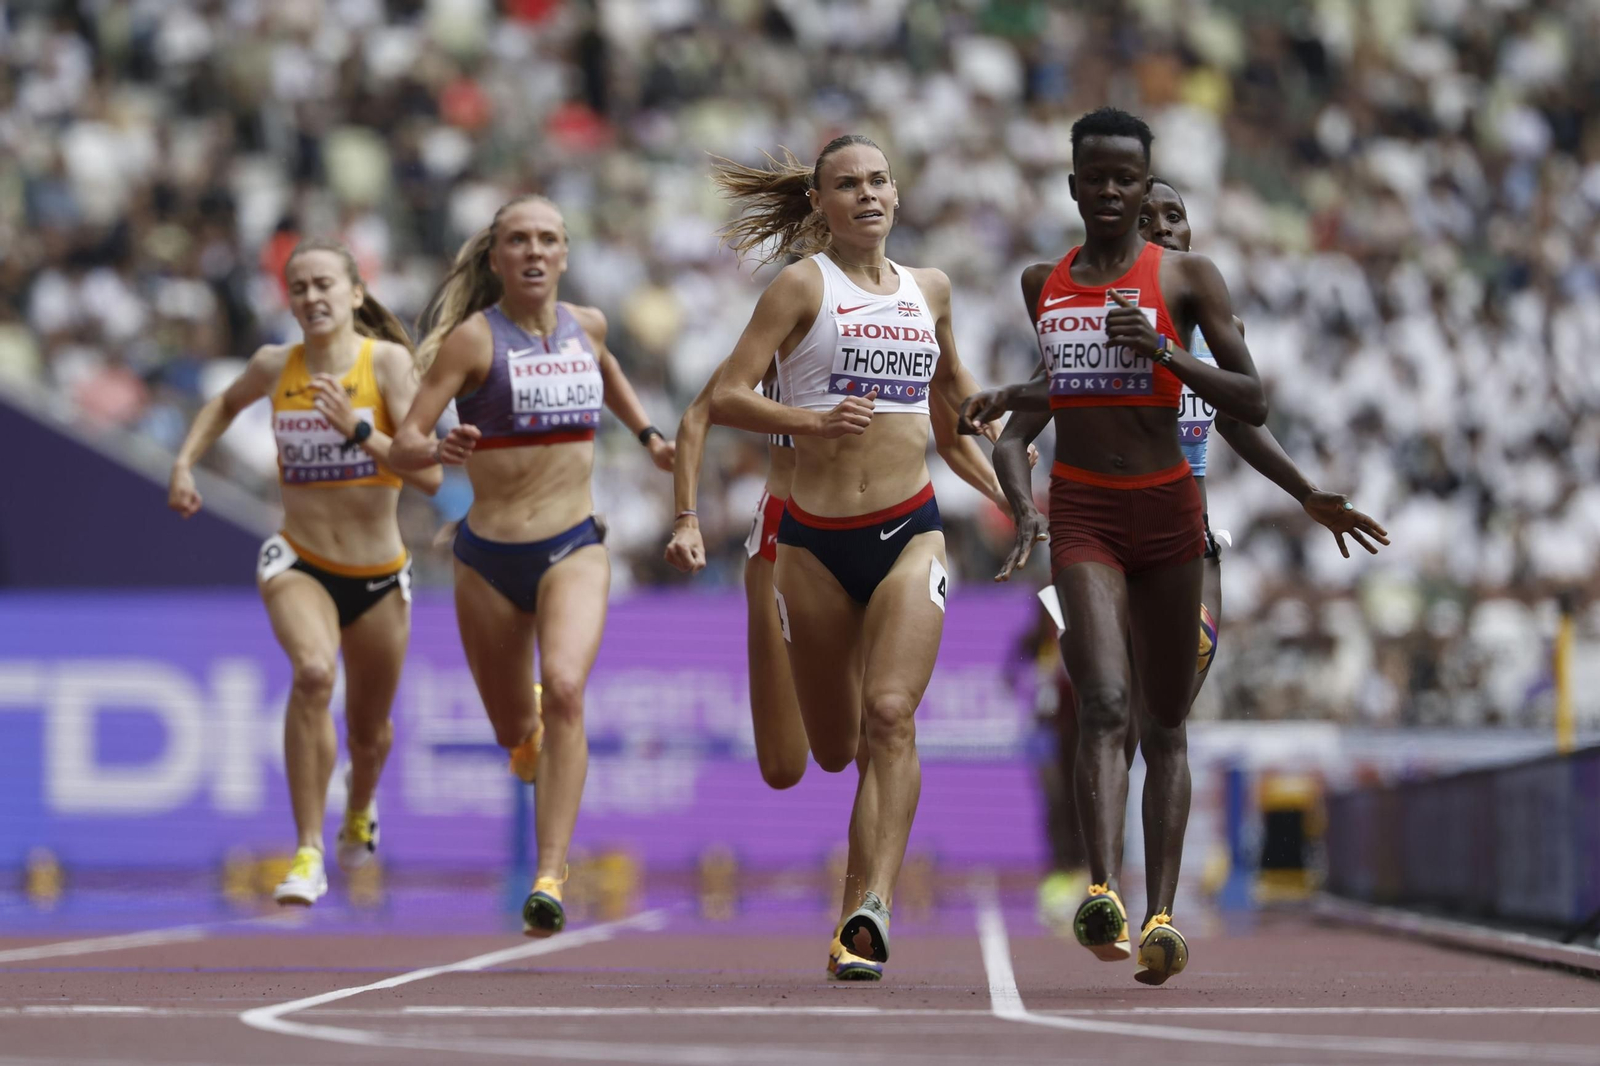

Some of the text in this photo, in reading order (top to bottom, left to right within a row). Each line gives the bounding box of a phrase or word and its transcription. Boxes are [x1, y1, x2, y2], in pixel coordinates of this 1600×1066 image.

[840, 323, 936, 345] HONDA
[1040, 316, 1107, 334] HON
[841, 347, 933, 378] THORNER
[1045, 343, 1147, 371] CHEROTICH
[279, 417, 331, 433] HON
